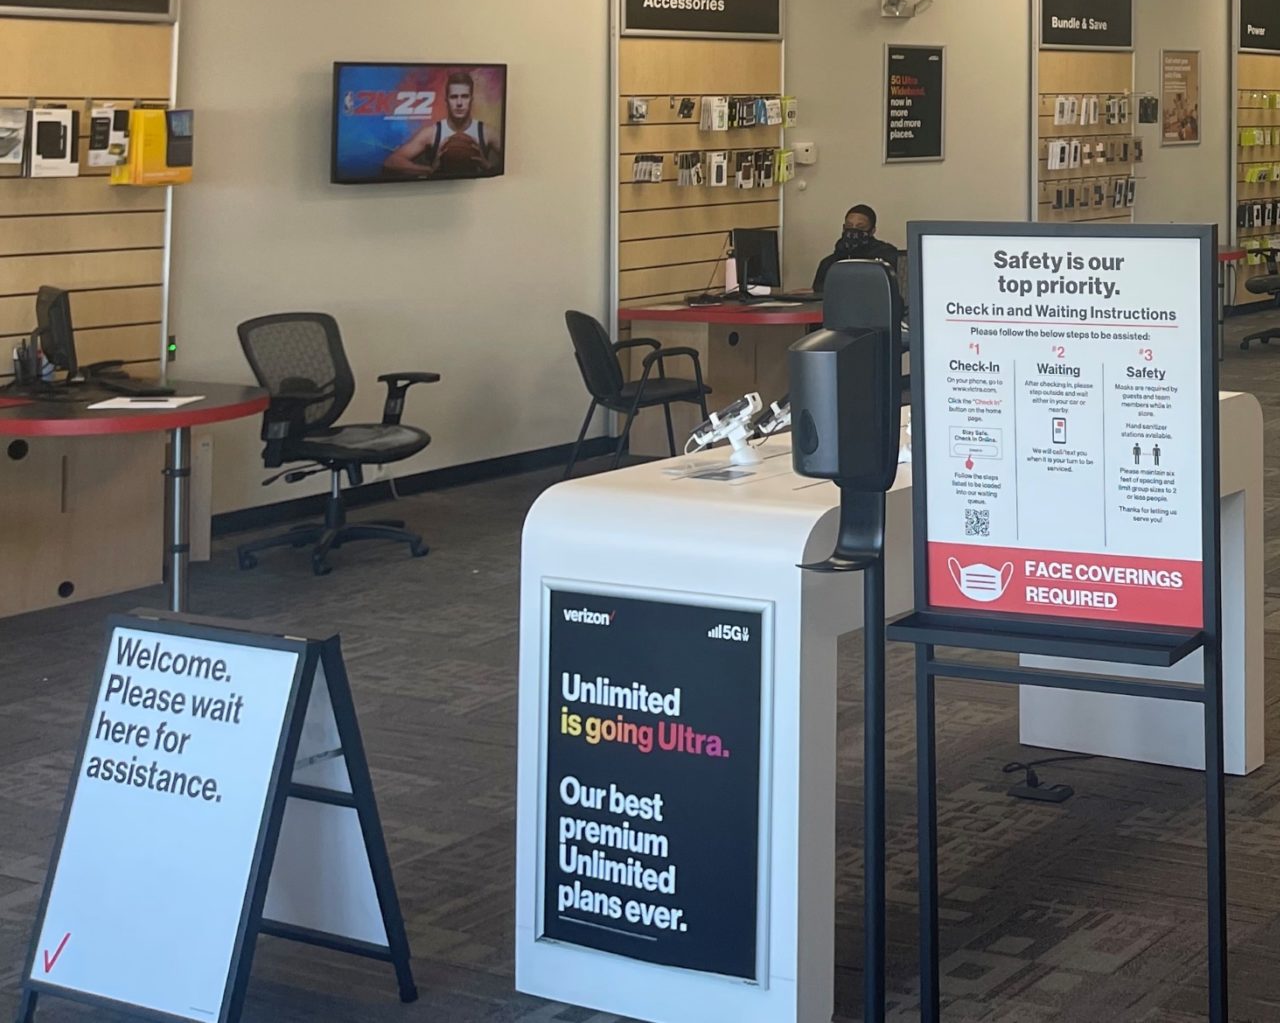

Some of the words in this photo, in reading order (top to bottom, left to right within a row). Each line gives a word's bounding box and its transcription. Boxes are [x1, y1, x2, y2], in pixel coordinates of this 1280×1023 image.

[1052, 16, 1080, 29] Bundle
[1081, 19, 1087, 29] &
[1089, 18, 1107, 31] Save
[1247, 24, 1265, 36] Power
[890, 98, 905, 107] now
[905, 97, 912, 107] in
[890, 109, 908, 117] more
[890, 119, 904, 128] and
[904, 120, 921, 128] more
[890, 130, 914, 140] places.
[993, 250, 1063, 274] Safety
[1066, 252, 1084, 270] is
[1088, 256, 1125, 271] our
[998, 275, 1032, 297] top
[1036, 276, 1120, 299] priority.
[946, 302, 989, 316] Check
[992, 303, 1004, 316] in
[1006, 304, 1032, 317] and
[1035, 304, 1087, 320] Waiting
[1090, 306, 1177, 321] Instructions
[970, 327, 998, 336] Please
[999, 328, 1024, 337] follow
[1025, 329, 1039, 337] the
[1040, 329, 1065, 338] below
[1066, 331, 1090, 340] steps
[1090, 331, 1100, 339] to
[1100, 331, 1112, 340] be
[1112, 332, 1151, 341] assisted:
[949, 360, 1000, 372] Check-In
[1037, 363, 1081, 377] Waiting
[1126, 366, 1166, 380] Safety
[1040, 381, 1066, 389] checking
[1150, 507, 1169, 516] letting
[1025, 561, 1073, 580] FACE
[1075, 564, 1183, 588] COVERINGS
[1026, 587, 1118, 609] REQUIRED
[563, 608, 610, 626] verizon
[117, 636, 232, 682] Welcome.
[104, 674, 186, 714] Please
[192, 692, 243, 724] wait
[561, 672, 680, 716] Unlimited
[95, 711, 150, 747] here
[154, 721, 191, 754] for
[561, 706, 582, 736] is
[585, 714, 653, 753] going
[657, 721, 730, 758] Ultra.
[86, 755, 222, 802] assistance.
[559, 776, 607, 810] Our
[609, 784, 664, 822] best
[559, 816, 669, 858] premium
[559, 844, 676, 895] Unlimited
[558, 881, 623, 920] plans
[625, 899, 688, 932] ever.
